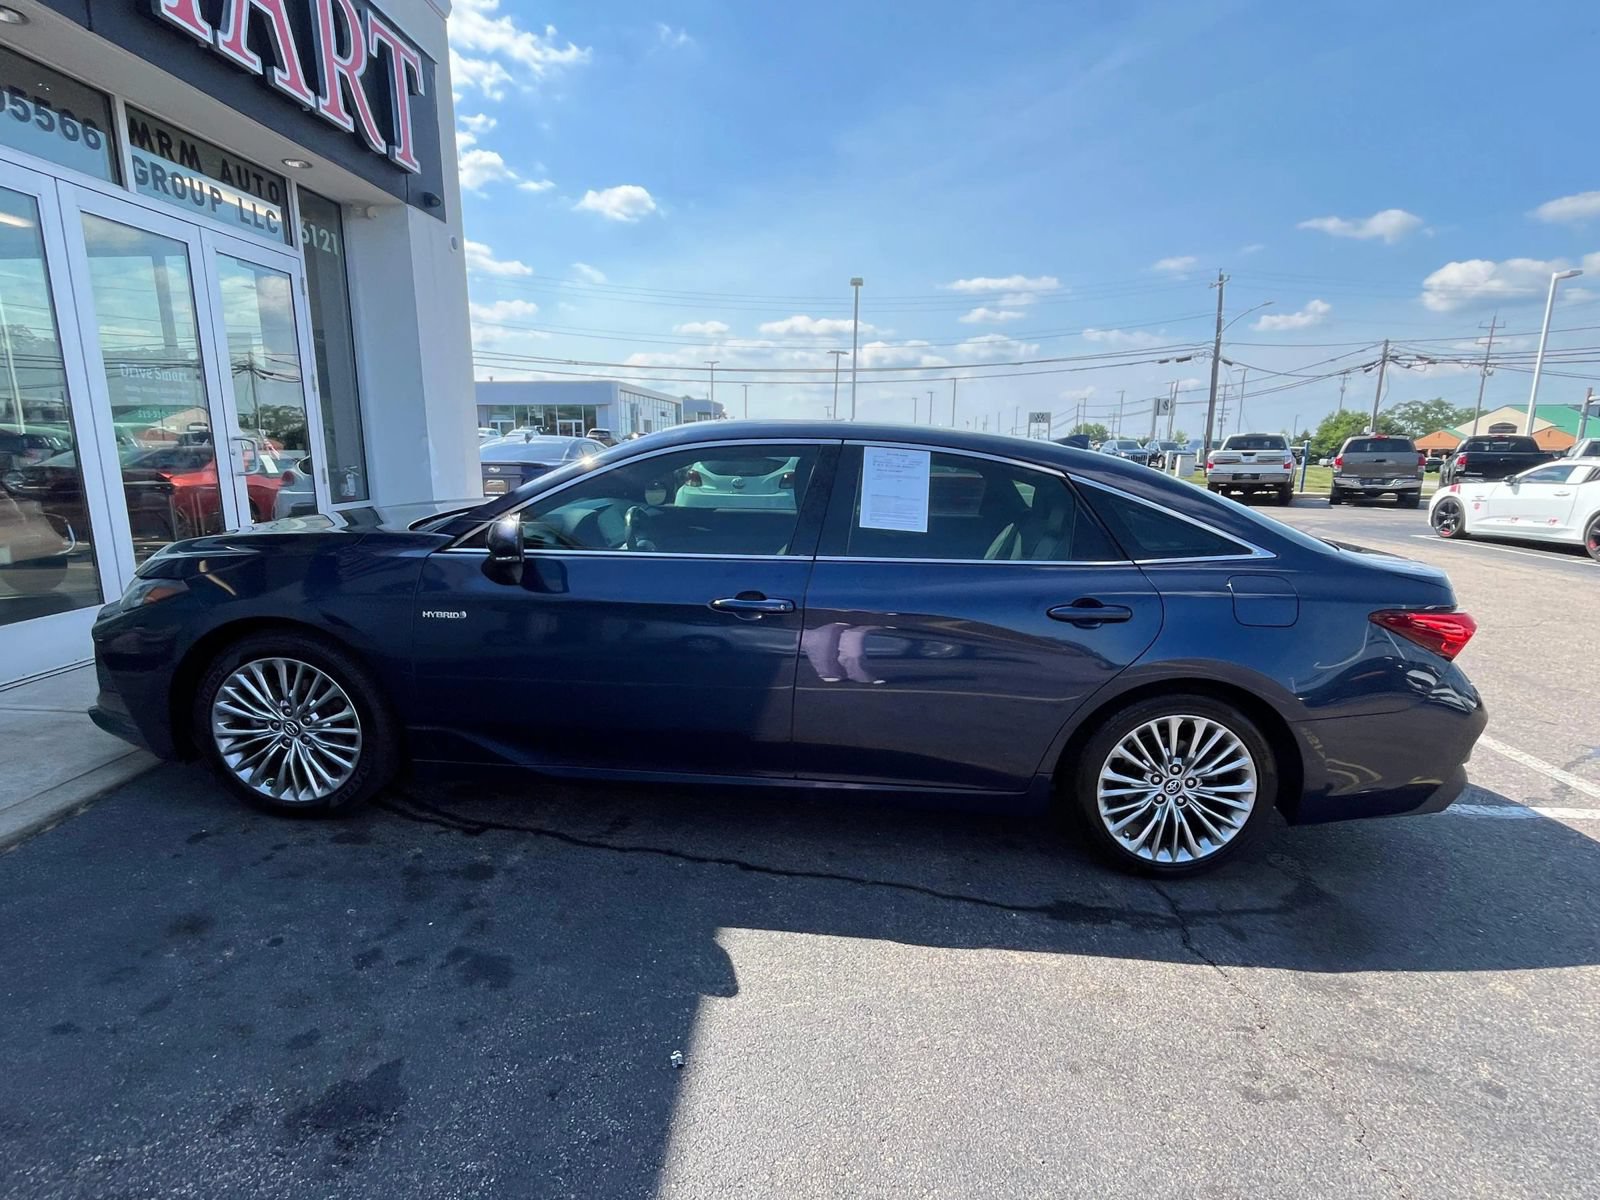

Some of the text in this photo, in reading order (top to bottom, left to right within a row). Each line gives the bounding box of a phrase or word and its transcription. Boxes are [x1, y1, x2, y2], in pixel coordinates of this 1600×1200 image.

[128, 116, 280, 206] MRM AUTO
[131, 154, 278, 235] GROUP LLC
[422, 610, 460, 619] HYBRID
